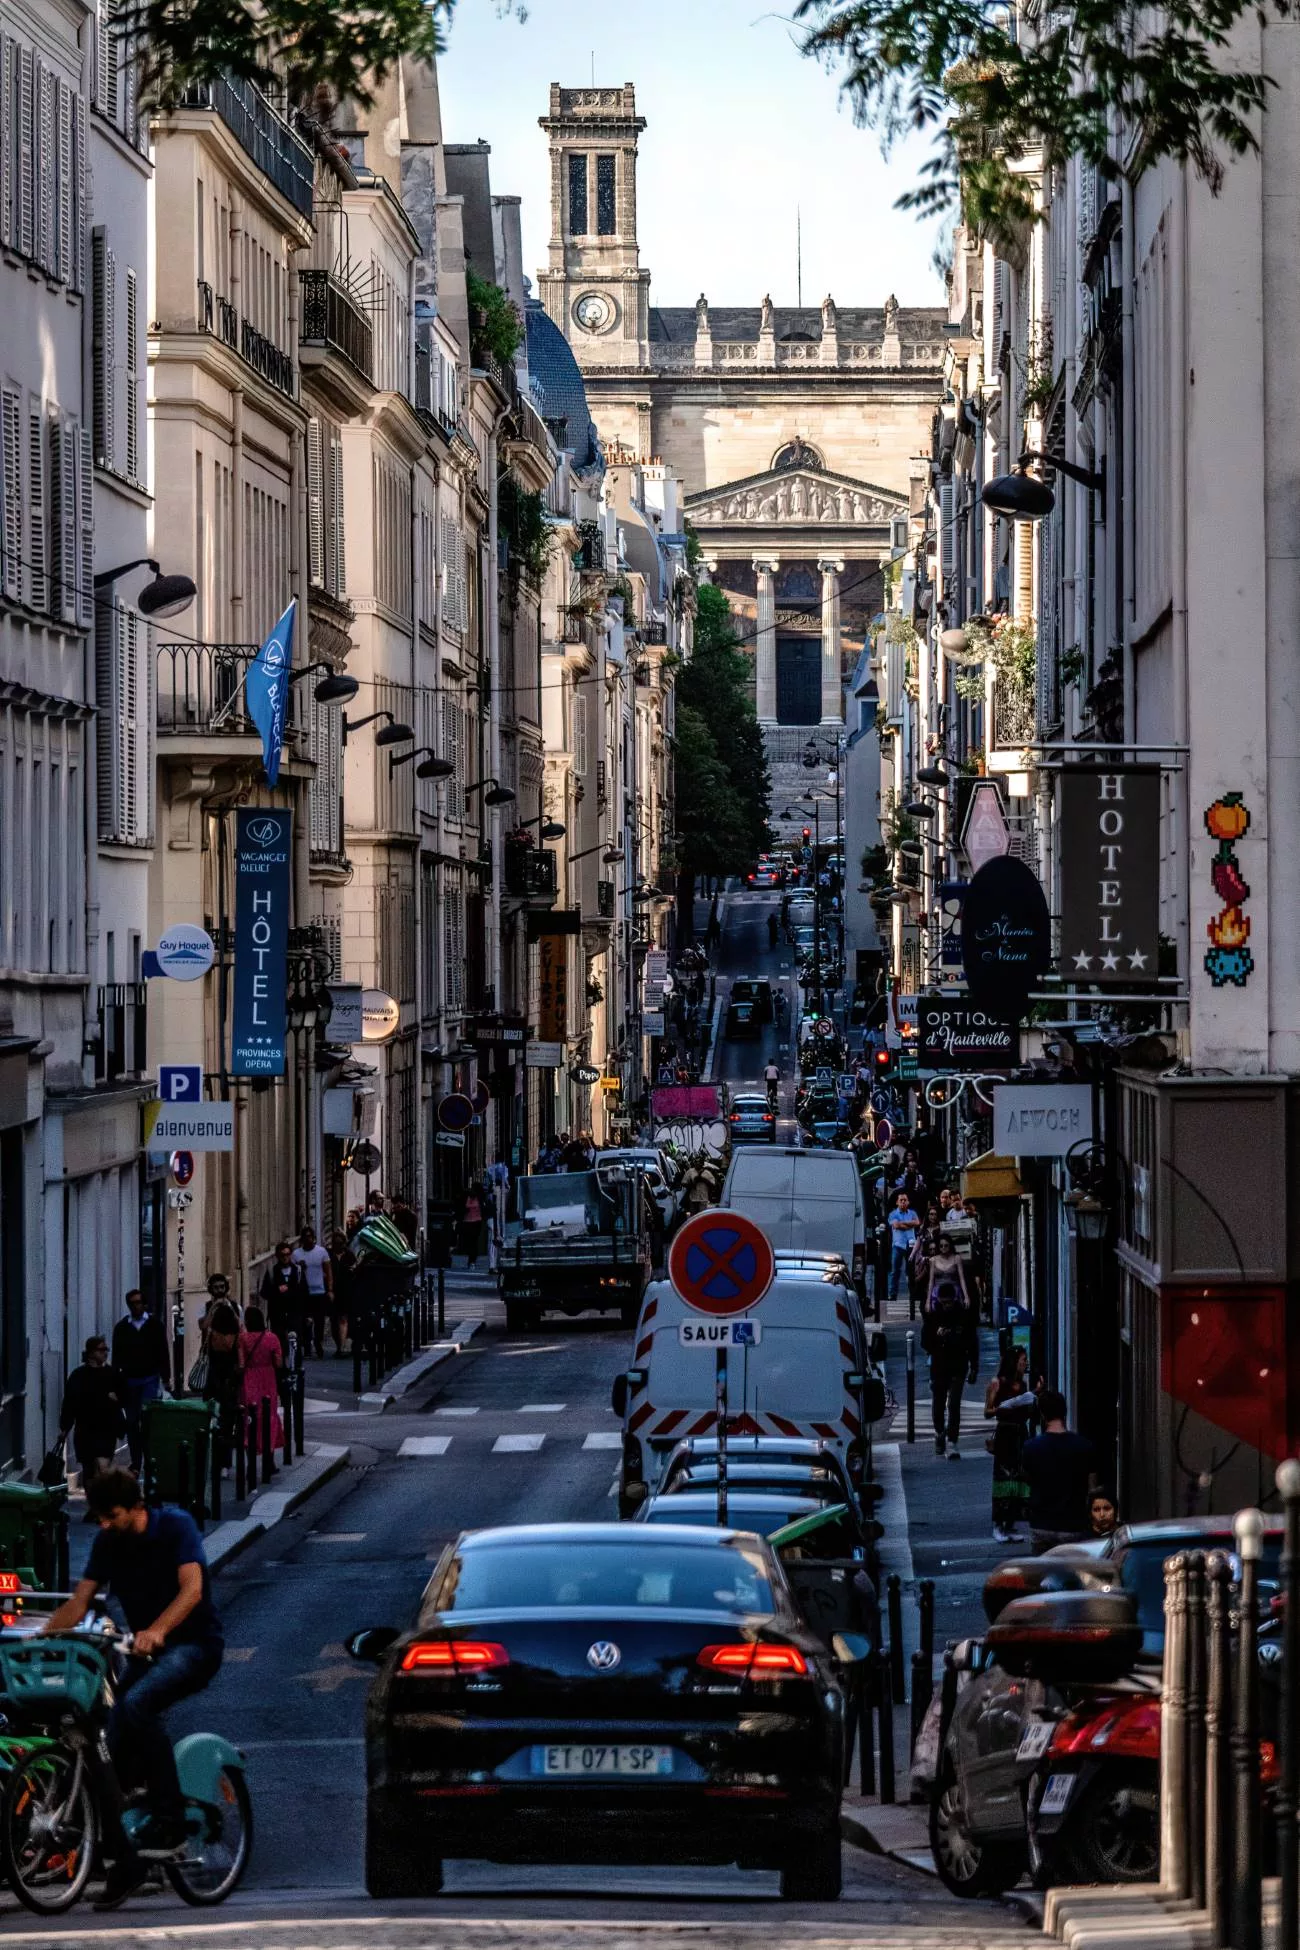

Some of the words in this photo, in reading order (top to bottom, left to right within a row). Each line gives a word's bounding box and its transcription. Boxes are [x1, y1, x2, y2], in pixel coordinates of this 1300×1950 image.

[1098, 774, 1125, 942] HOTEL
[160, 941, 177, 950] Guy
[179, 941, 210, 950] Hoquet
[252, 890, 271, 1025] HÔTEL
[926, 1012, 1010, 1026] OPTIQ
[236, 1049, 281, 1058] PROVINCES
[170, 1073, 190, 1100] P
[683, 1326, 729, 1341] SAUF
